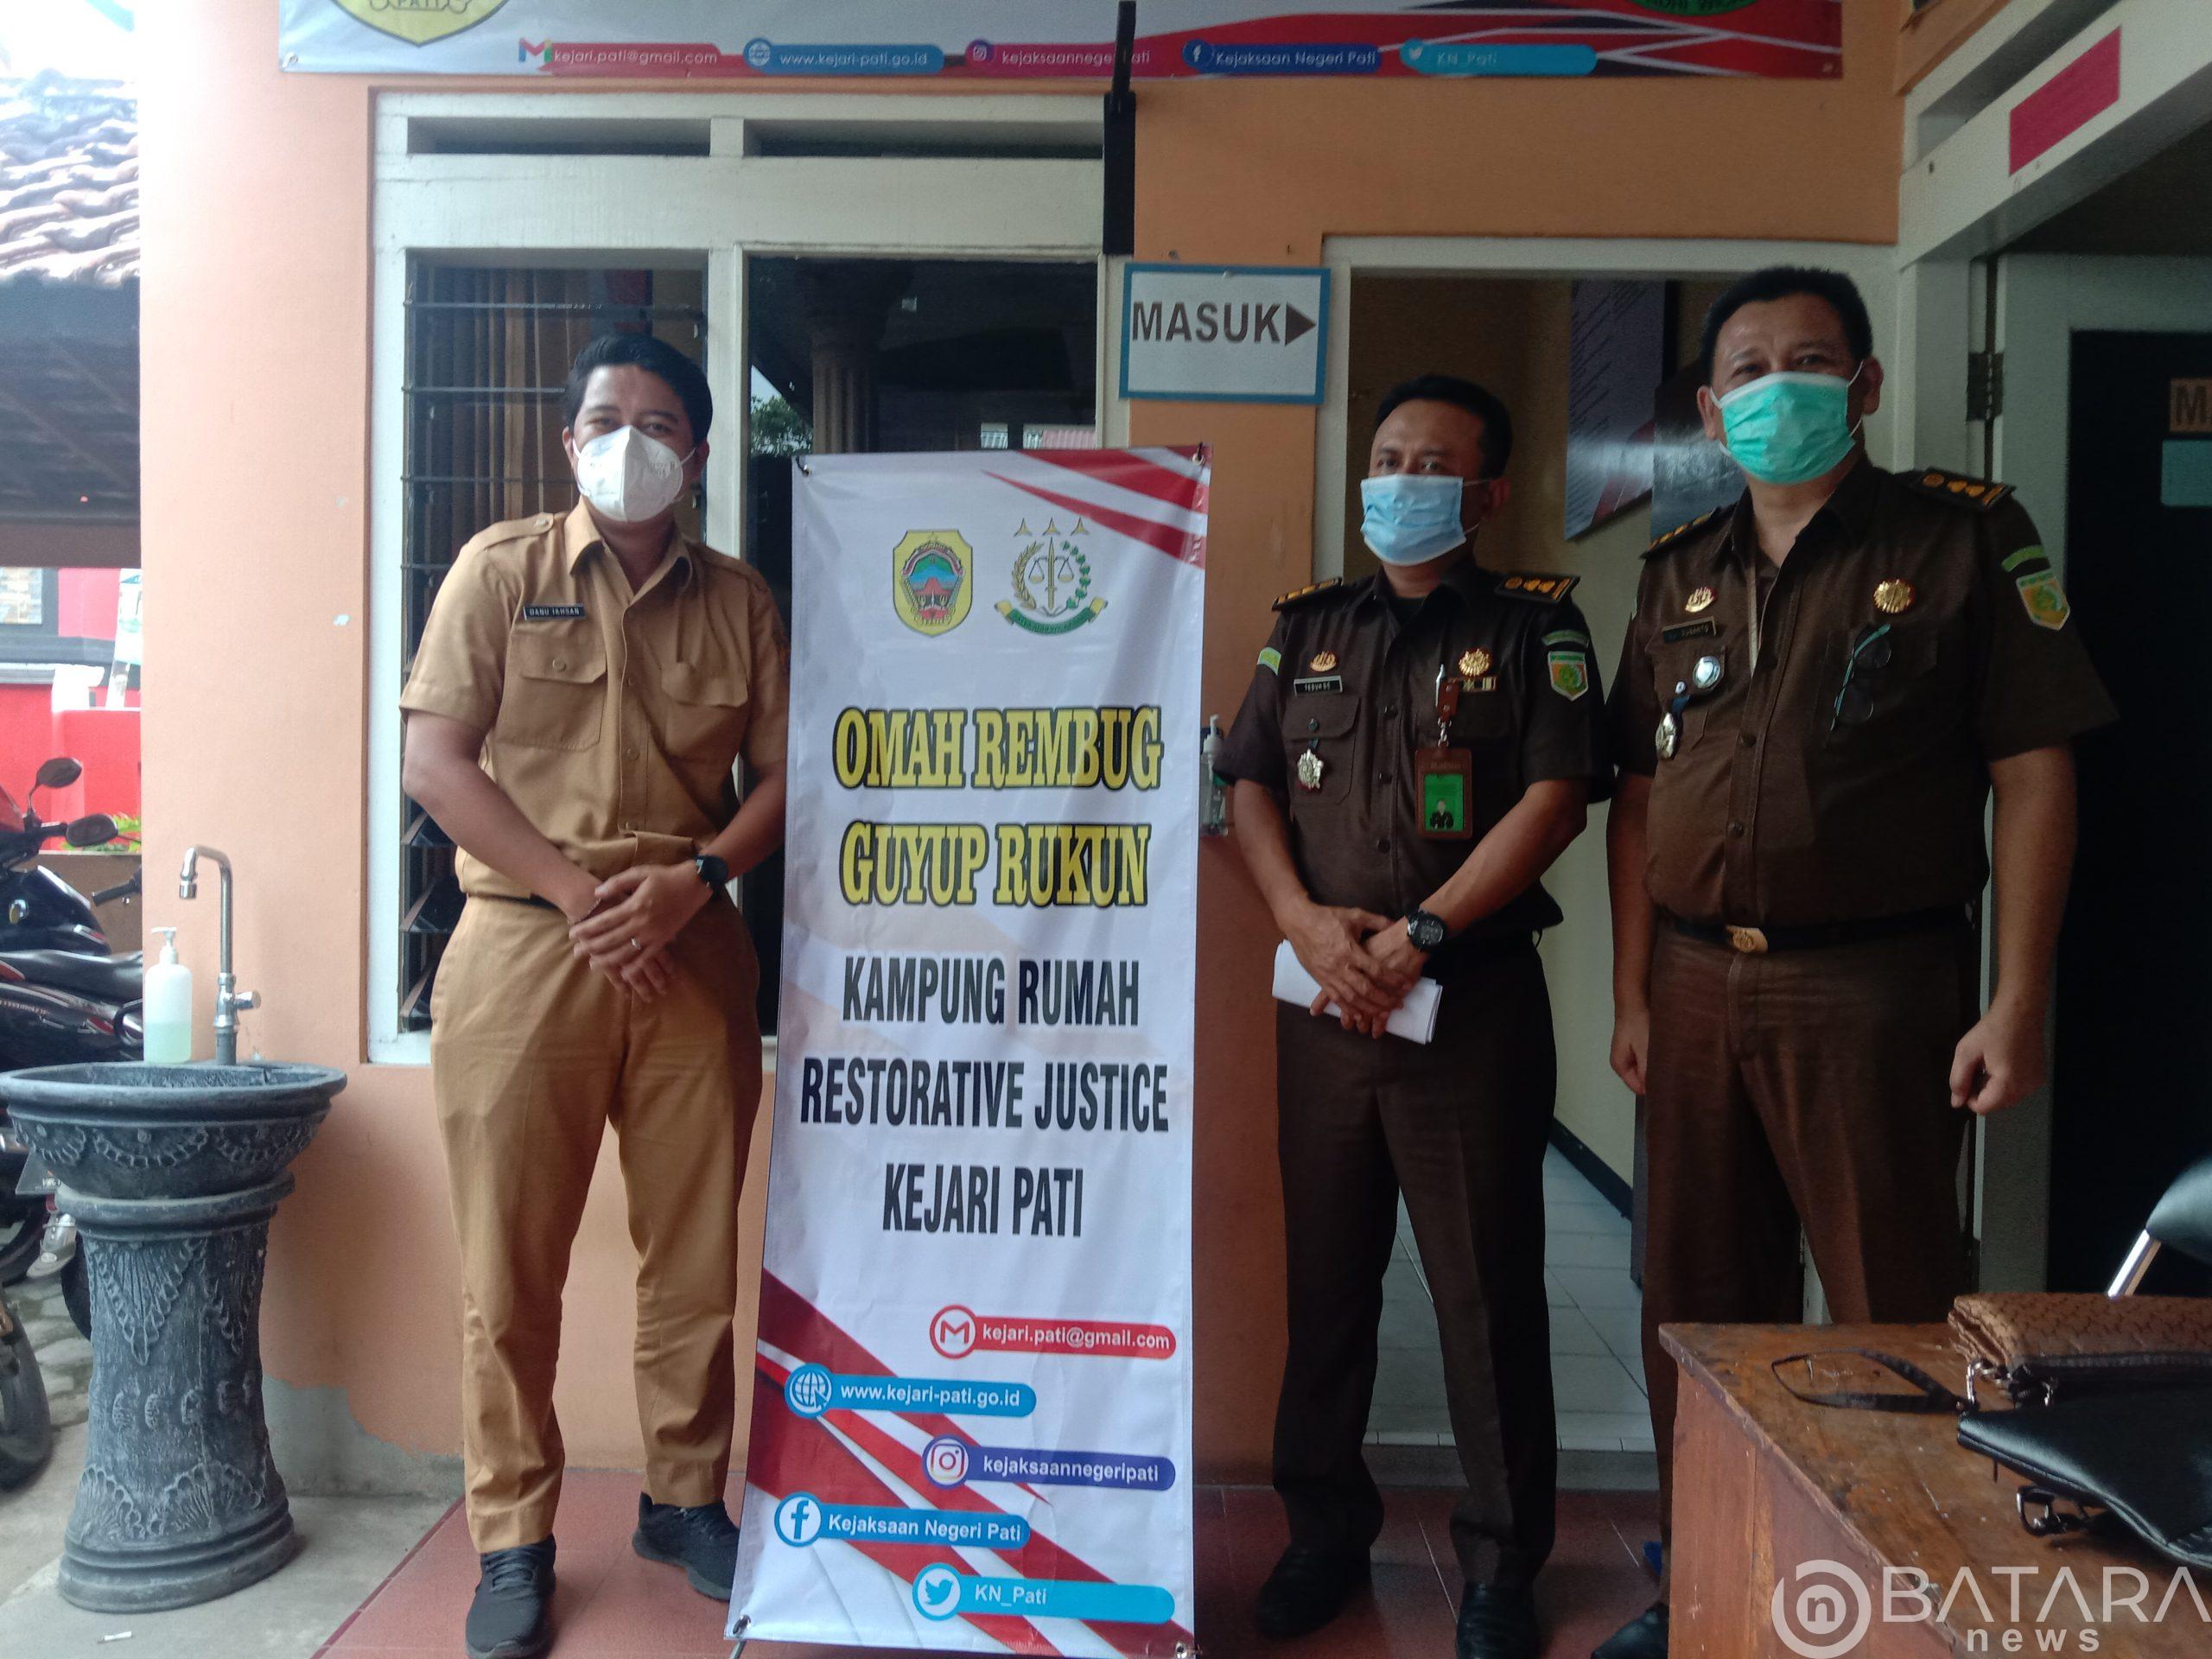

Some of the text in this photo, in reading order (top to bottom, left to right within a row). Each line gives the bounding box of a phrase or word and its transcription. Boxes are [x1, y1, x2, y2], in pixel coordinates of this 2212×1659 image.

[553, 49, 718, 65] kejari.pati@gmail.com
[780, 52, 928, 68] www.kejari-pati.go.id
[1217, 51, 1376, 68] Kejaksaan Negeri Pati
[1132, 302, 1281, 342] MASUK
[832, 706, 1165, 790] OMAH REMBUG
[840, 820, 1152, 906] GUYUP RUKUN
[842, 957, 1139, 1027] KAMPUNG RUMAH
[800, 1057, 1168, 1133] RESTORATIVE JUSTICE
[882, 1163, 1084, 1237] KEJARI PATI
[982, 1323, 1170, 1350] kejari.pati@gmail.com
[841, 1384, 1020, 1409] www.kejari-pati.go.id
[983, 1455, 1159, 1484] kejaksaannegeripati
[828, 1514, 1021, 1542] Kejaksaan Negeri Pati
[975, 1583, 1047, 1607] KN_Pati
